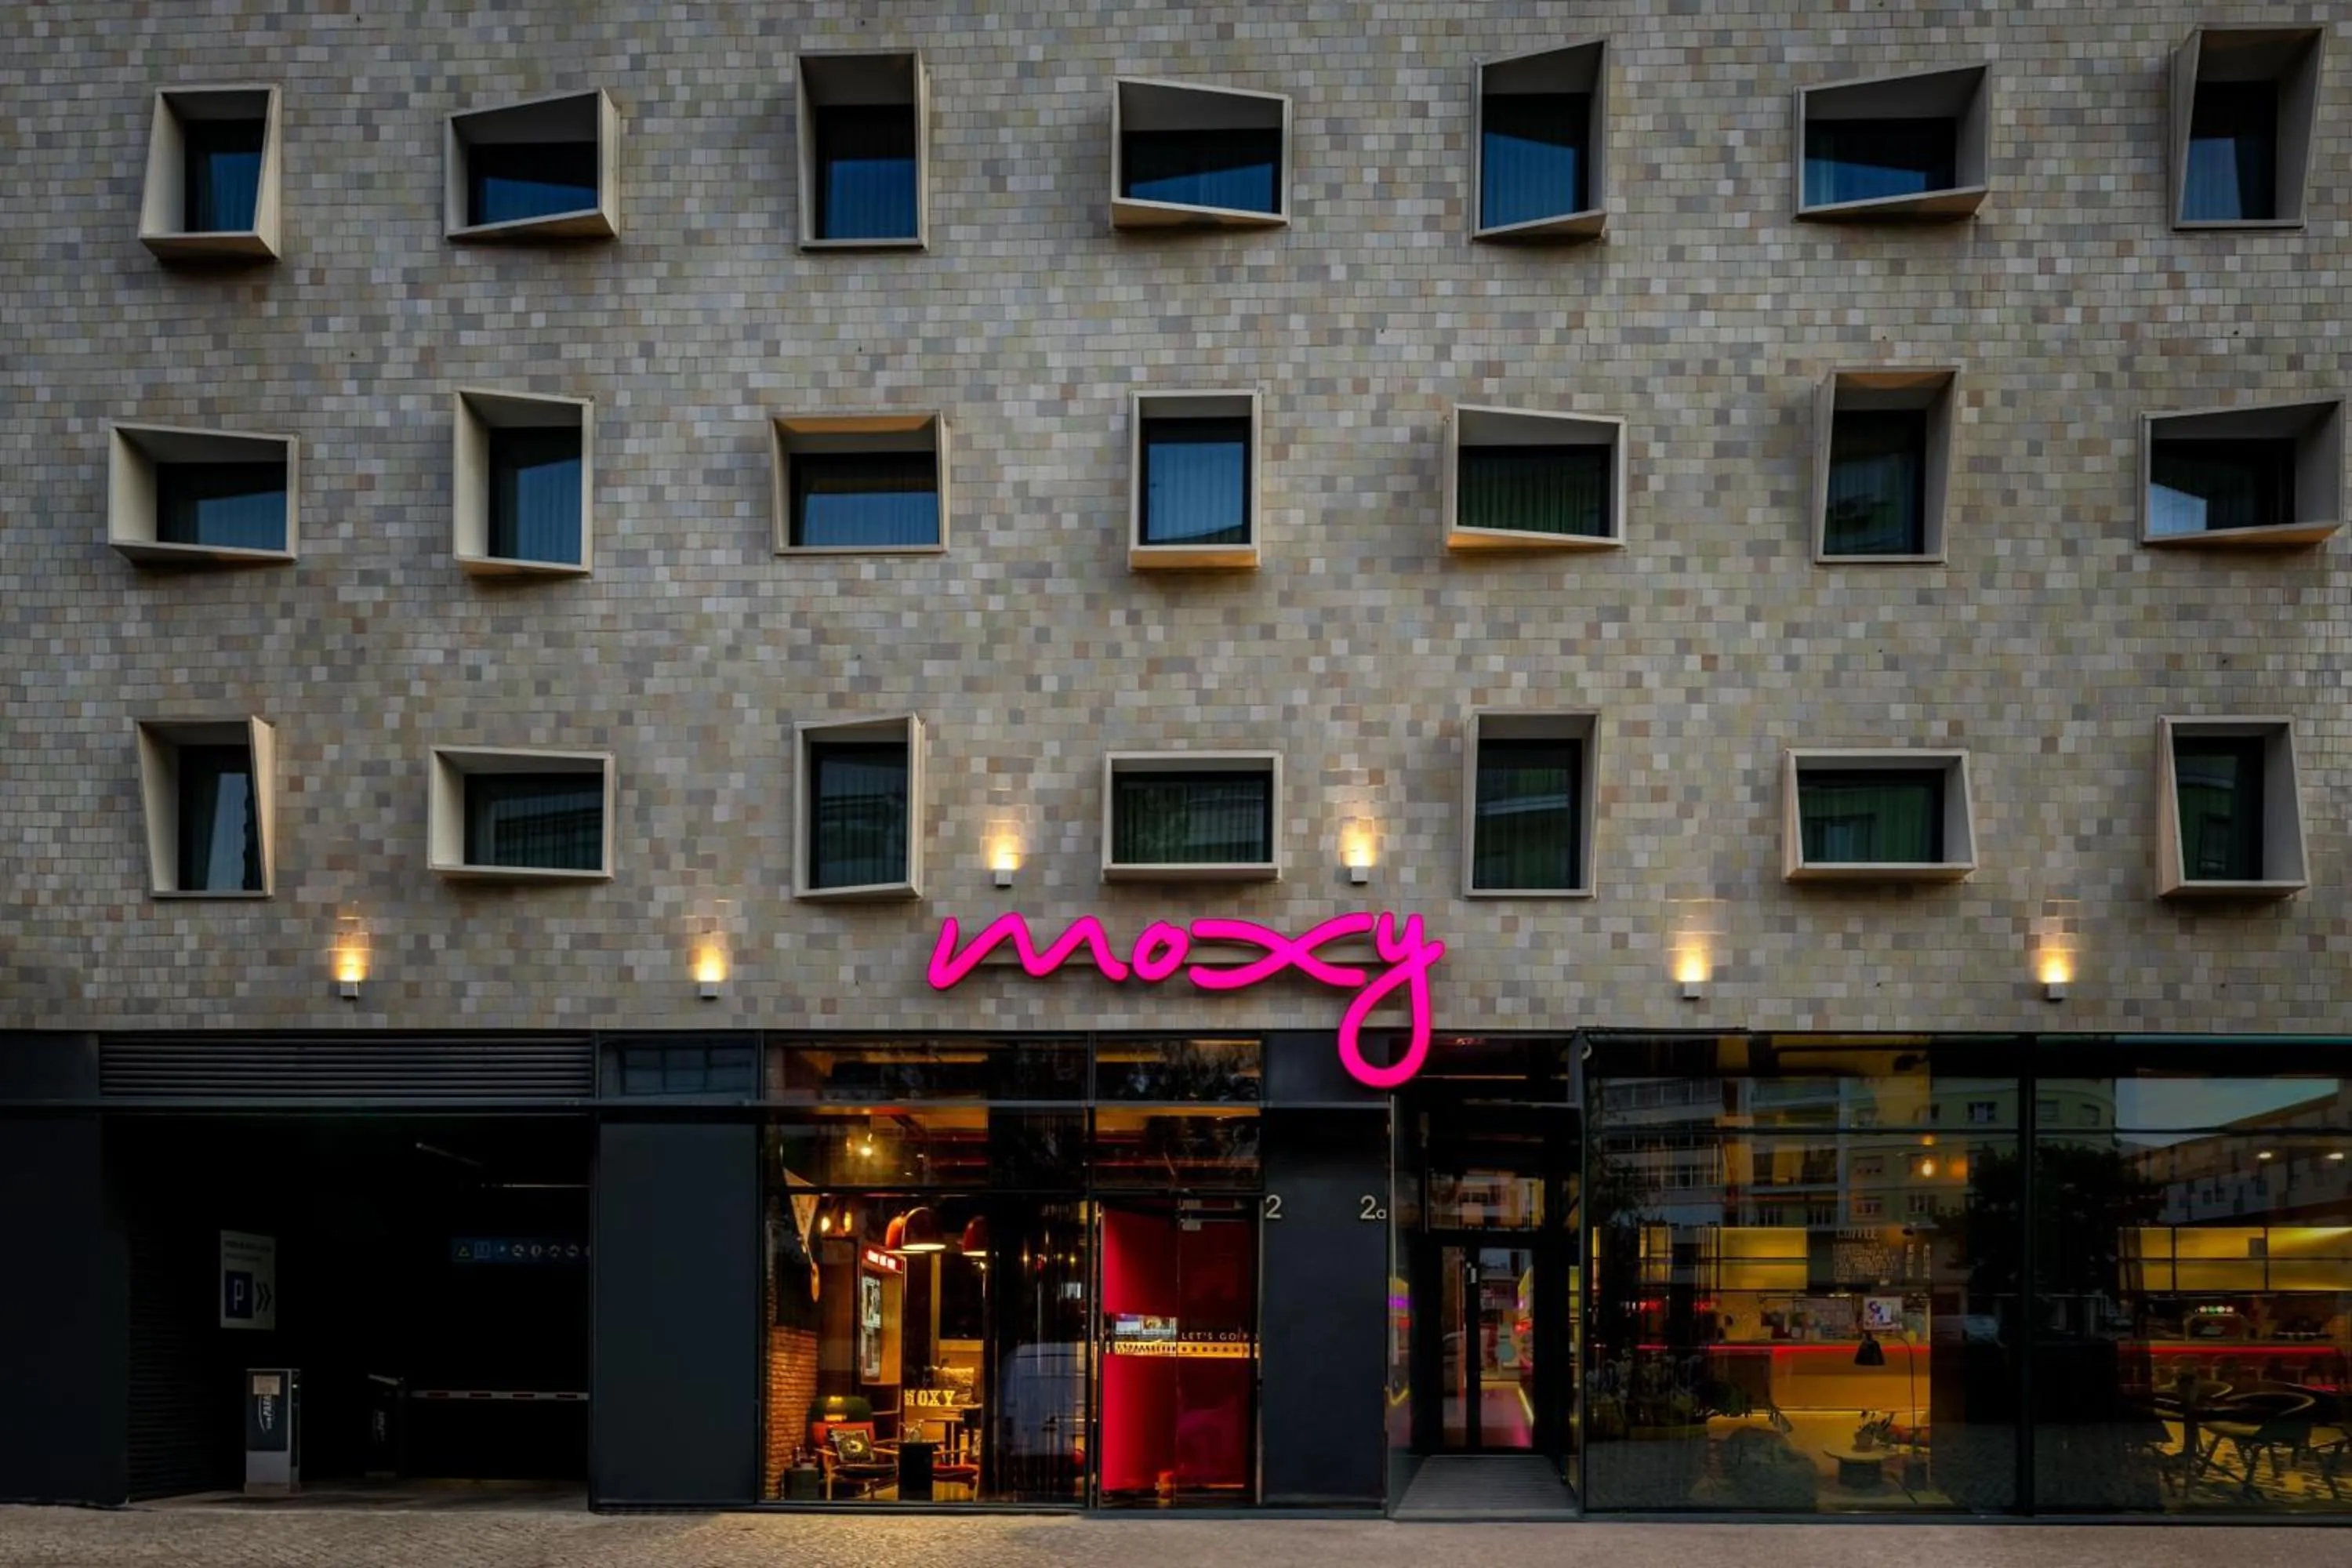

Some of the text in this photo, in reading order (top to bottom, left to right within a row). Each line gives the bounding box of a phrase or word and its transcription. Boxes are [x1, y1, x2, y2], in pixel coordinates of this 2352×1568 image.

[1265, 1194, 1283, 1219] 2
[1359, 1195, 1386, 1220] 2a
[233, 1278, 245, 1312] P
[1181, 1331, 1213, 1341] LET'S
[1219, 1331, 1237, 1341] GO
